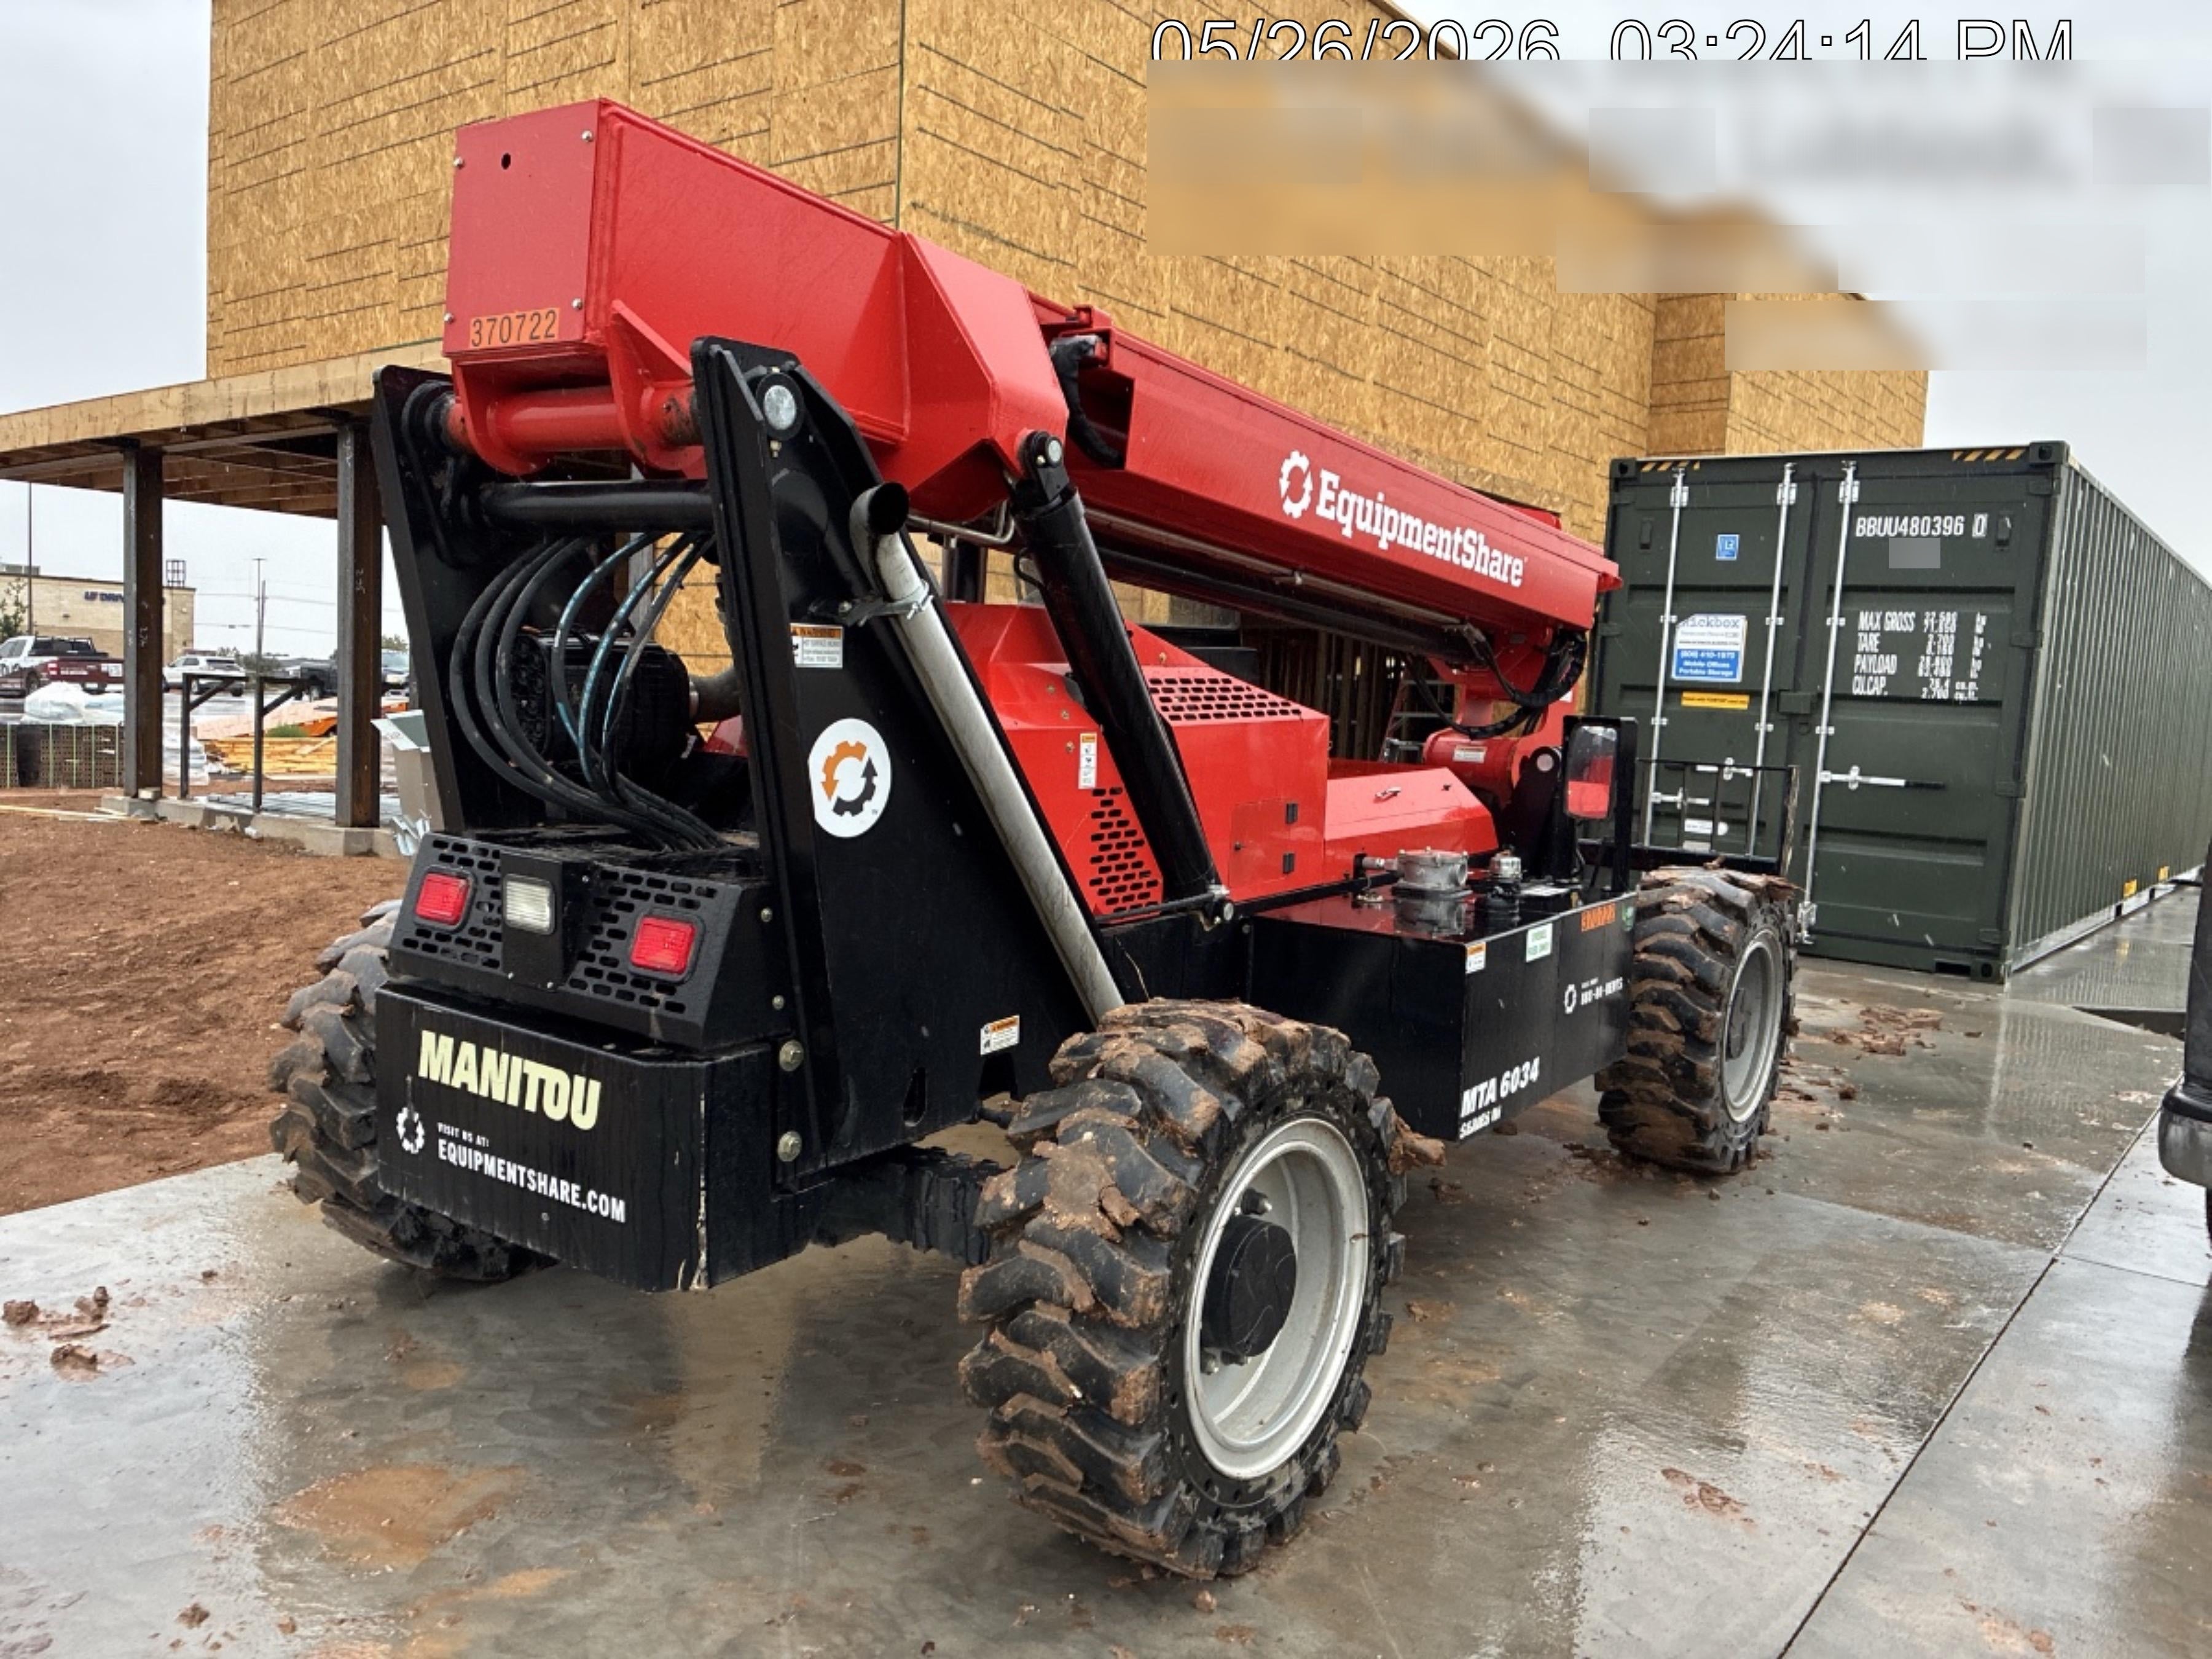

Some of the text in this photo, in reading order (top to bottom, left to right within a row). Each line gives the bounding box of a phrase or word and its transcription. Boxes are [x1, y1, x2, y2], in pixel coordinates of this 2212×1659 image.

[471, 309, 557, 347] 370722
[1316, 469, 1524, 588] EquipmentShare
[1855, 514, 1988, 538] BBUU480396 0
[1857, 611, 1882, 632] MAX
[1883, 611, 1916, 632] GROSS
[1857, 632, 1881, 653] TARE
[1853, 654, 1898, 675] PAYLOAD
[418, 1029, 602, 1131] MANITOU
[1460, 1056, 1540, 1118] MTA 6034
[437, 1122, 489, 1147] VISIT US AT:
[437, 1138, 626, 1223] EQUIPMENTSHARE.COM
